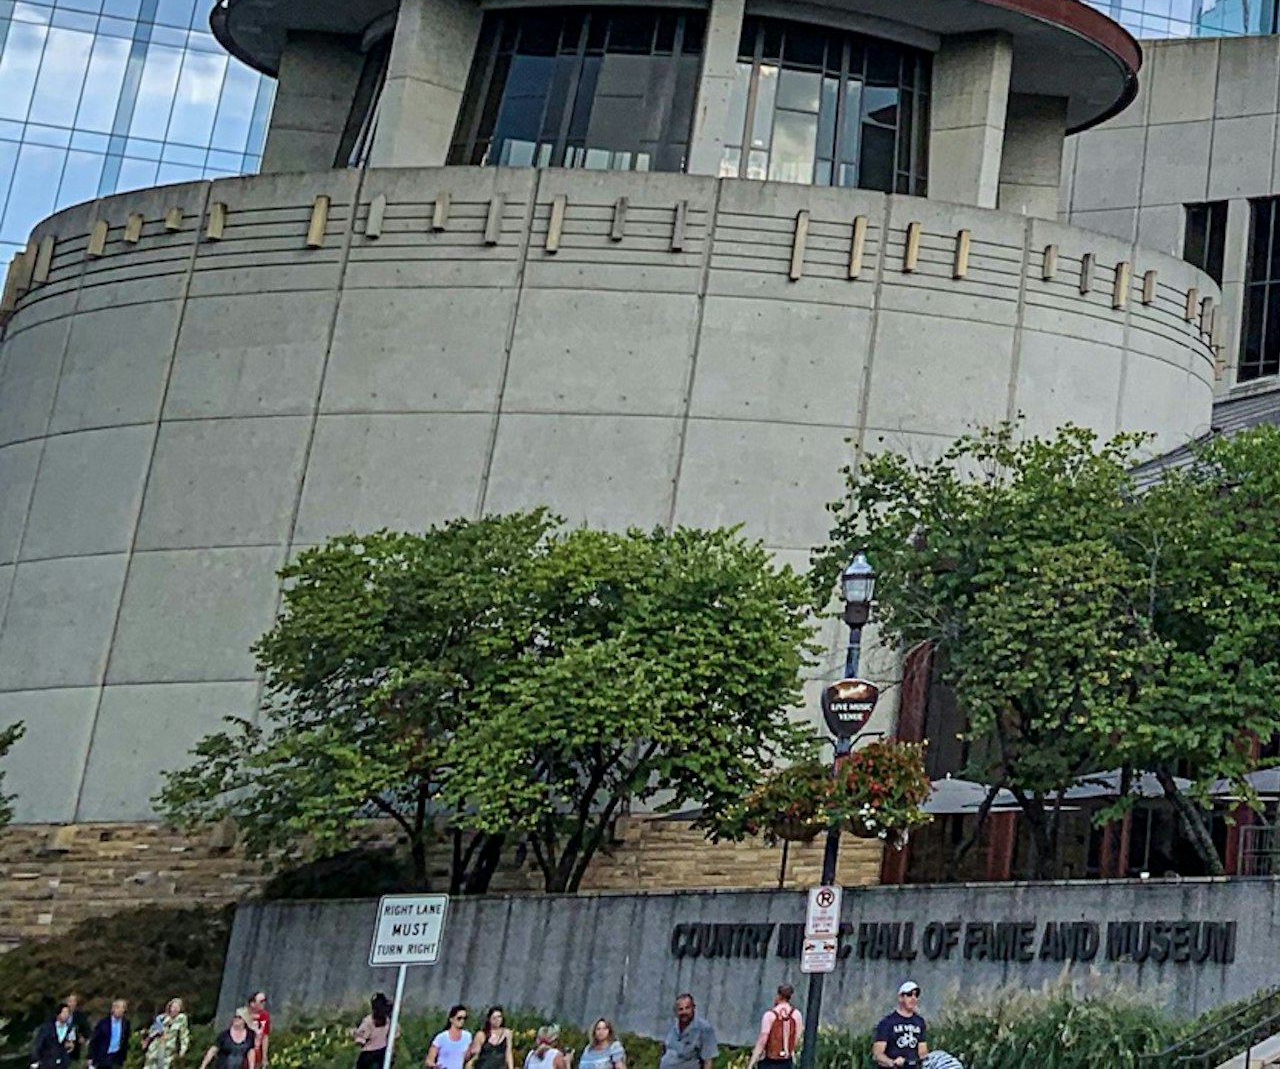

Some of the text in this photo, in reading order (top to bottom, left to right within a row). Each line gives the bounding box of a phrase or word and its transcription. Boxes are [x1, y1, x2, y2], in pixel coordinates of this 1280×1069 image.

[831, 702, 873, 711] LIVE MUSIC
[838, 713, 864, 721] VENUE
[384, 904, 442, 916] RIGHT LANE
[391, 922, 429, 937] MUST
[671, 922, 776, 960] COUNTRY
[856, 921, 917, 961] HALL
[922, 921, 962, 961] OF
[962, 920, 1037, 962] FAME
[1038, 921, 1099, 962] AND
[1105, 920, 1237, 964] MUSEUM
[377, 943, 436, 956] TURN RIGHT
